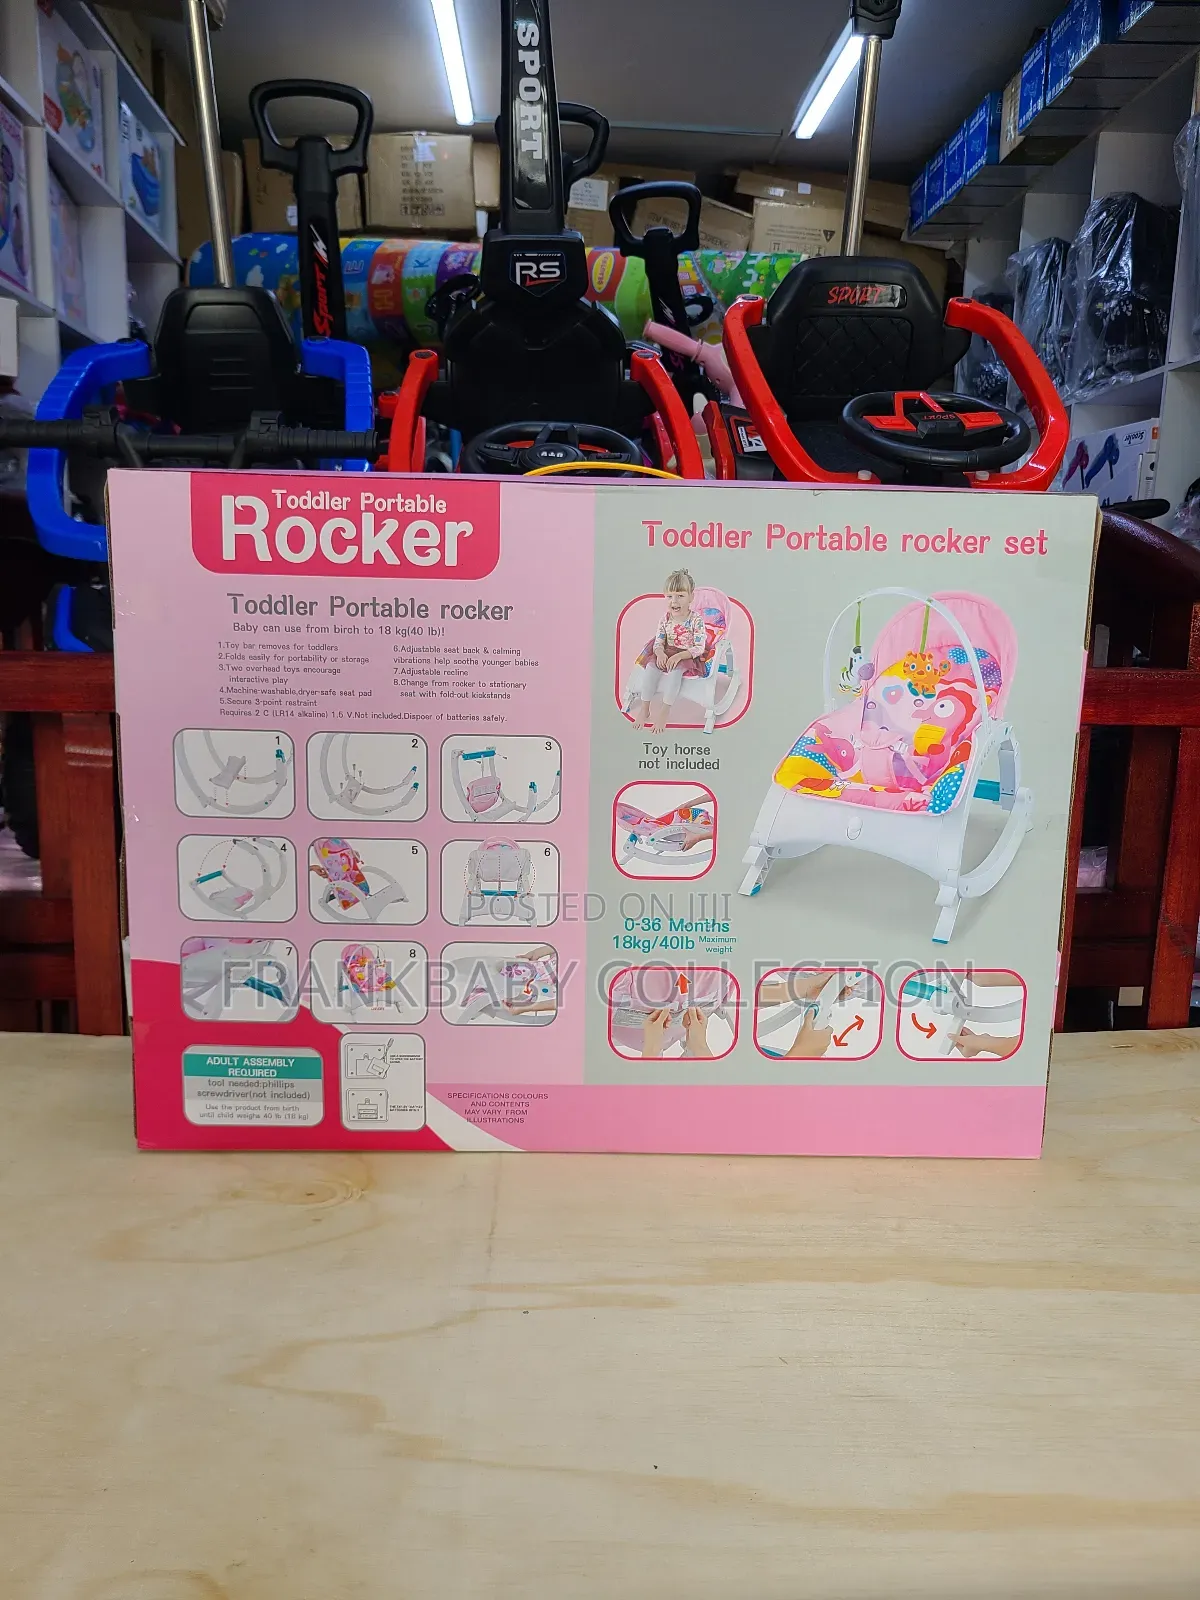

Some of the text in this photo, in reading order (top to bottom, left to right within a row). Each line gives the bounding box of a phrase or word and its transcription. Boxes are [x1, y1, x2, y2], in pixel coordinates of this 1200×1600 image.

[517, 22, 542, 161] SPORT
[515, 261, 560, 286] RS
[828, 286, 886, 304] SPORT
[272, 489, 447, 514] Toddler Portable
[220, 494, 474, 566] Rocker
[641, 520, 1049, 555] Toddler Portable rocker set
[227, 593, 513, 620] Toddler Portable rocker
[233, 623, 258, 633] Baby
[306, 624, 329, 633] from
[334, 625, 359, 634] birch
[364, 626, 373, 634] to
[379, 626, 391, 635] 18
[396, 626, 423, 637] kg(40
[428, 627, 445, 637] lb)!
[218, 642, 239, 650] 1.Toy
[393, 645, 440, 654] 6.Adjustable
[493, 648, 520, 656] calming
[249, 654, 270, 662] easily
[288, 654, 327, 663] portability
[342, 656, 369, 665] storage
[219, 664, 242, 672] 3.Two
[246, 665, 280, 673] overhead
[284, 666, 300, 674] toys
[393, 668, 440, 676] 7.Adjustable
[229, 676, 288, 685] interactive play
[490, 681, 527, 689] stationary
[440, 691, 468, 699] fold-out
[220, 698, 251, 706] 5.Secure
[255, 699, 282, 707] 3-point
[220, 709, 251, 717] Requires
[447, 713, 479, 721] batteries
[276, 736, 552, 751] 1 2 3
[644, 743, 711, 758] Toy horse
[639, 756, 720, 771] not included
[280, 844, 551, 857] 4 5 6
[625, 917, 729, 932] 0-36 Months
[612, 935, 695, 953] 18kg/40lb
[286, 947, 416, 958] 7 8
[705, 946, 732, 954] weight
[206, 1057, 295, 1066] ADULT ASSEMBLY
[228, 1068, 276, 1077] REQUIRED
[271, 1091, 310, 1100] included)
[236, 1104, 261, 1112] product
